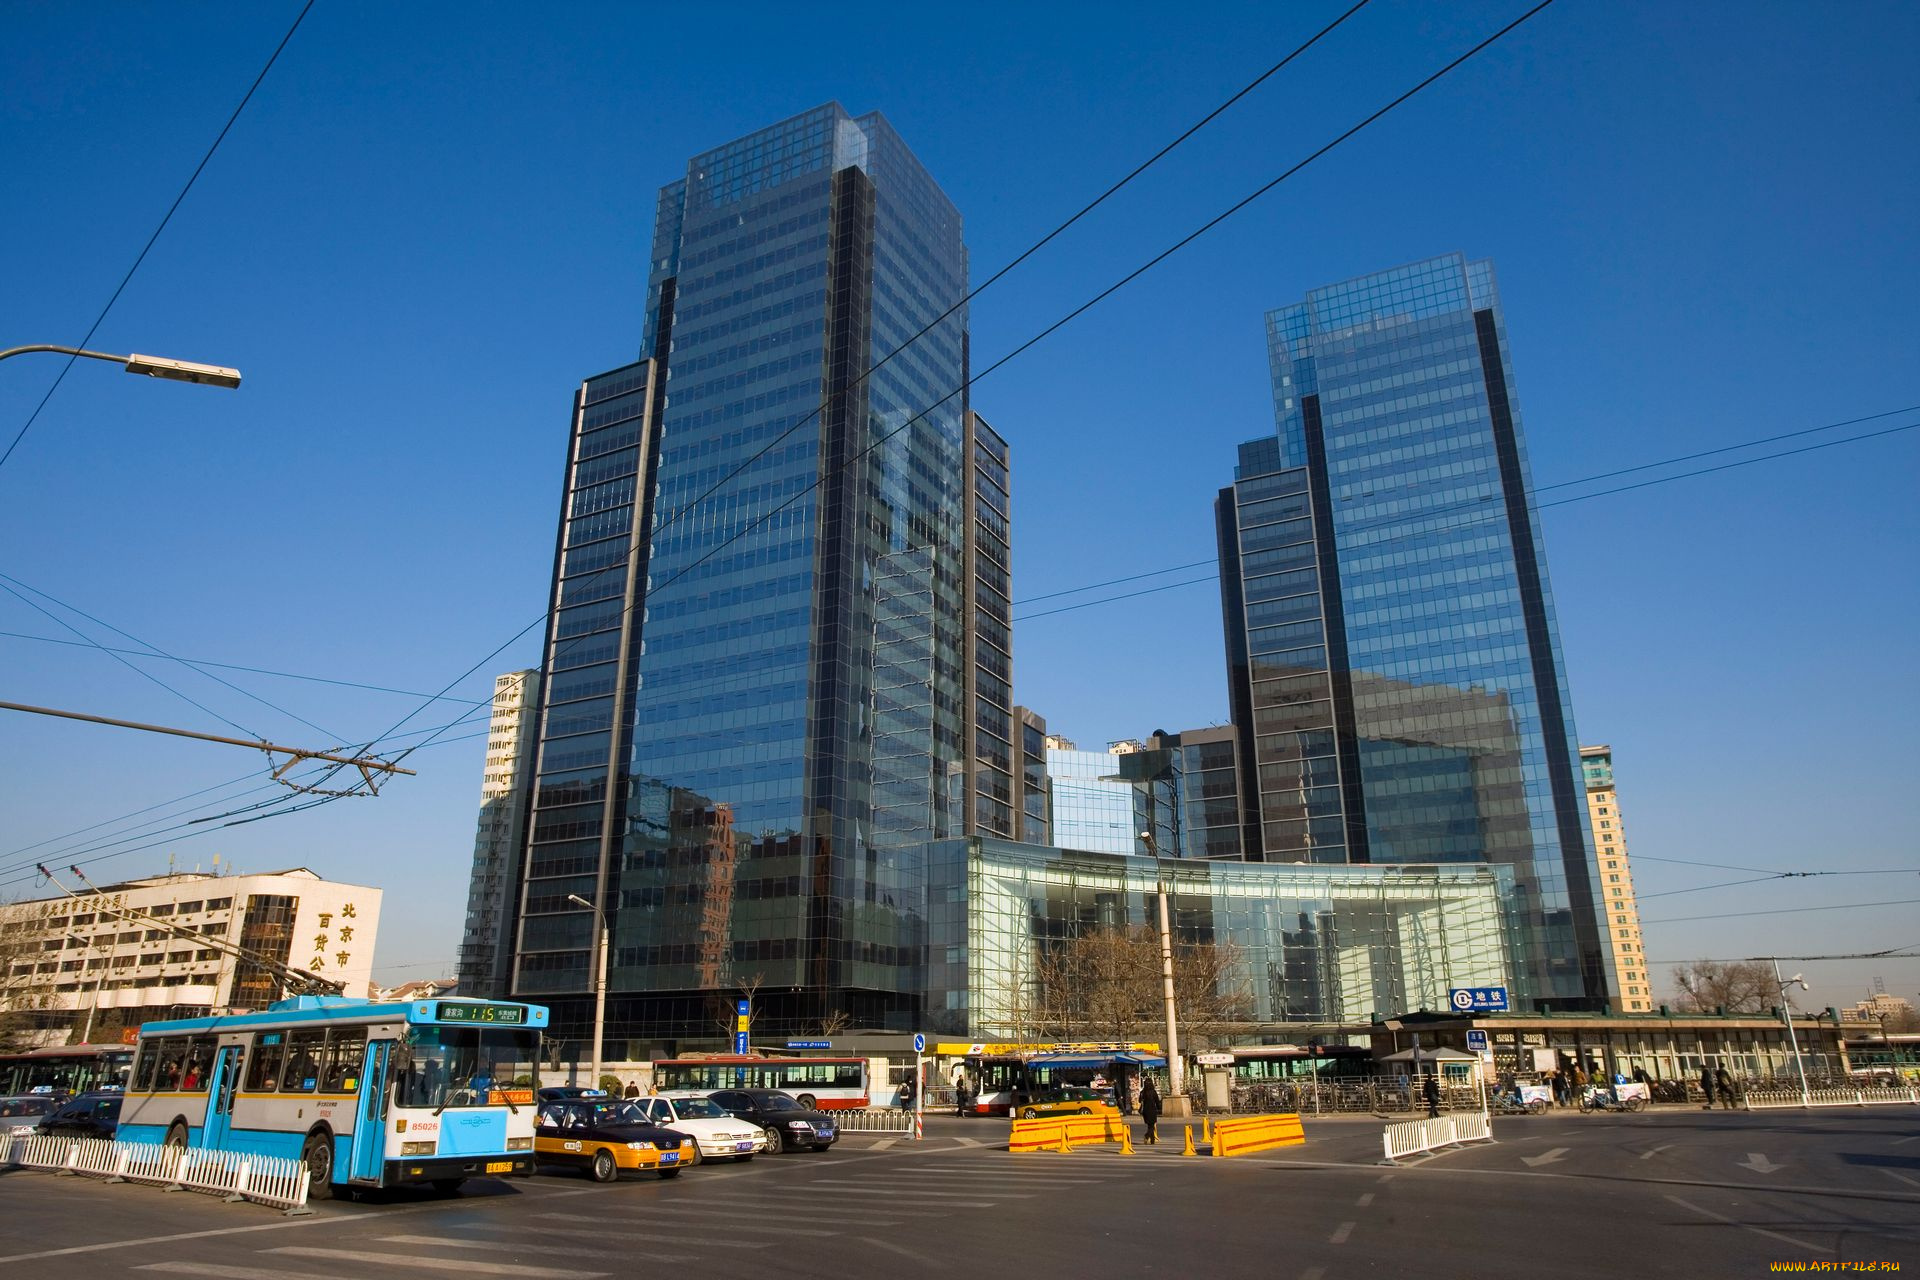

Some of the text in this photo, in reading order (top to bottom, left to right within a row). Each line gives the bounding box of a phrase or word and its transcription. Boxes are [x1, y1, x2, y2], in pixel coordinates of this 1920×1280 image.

[336, 902, 357, 968] 北京市
[1475, 991, 1502, 1001] 地铁
[471, 1007, 495, 1021] 115
[411, 1122, 439, 1131] 85026
